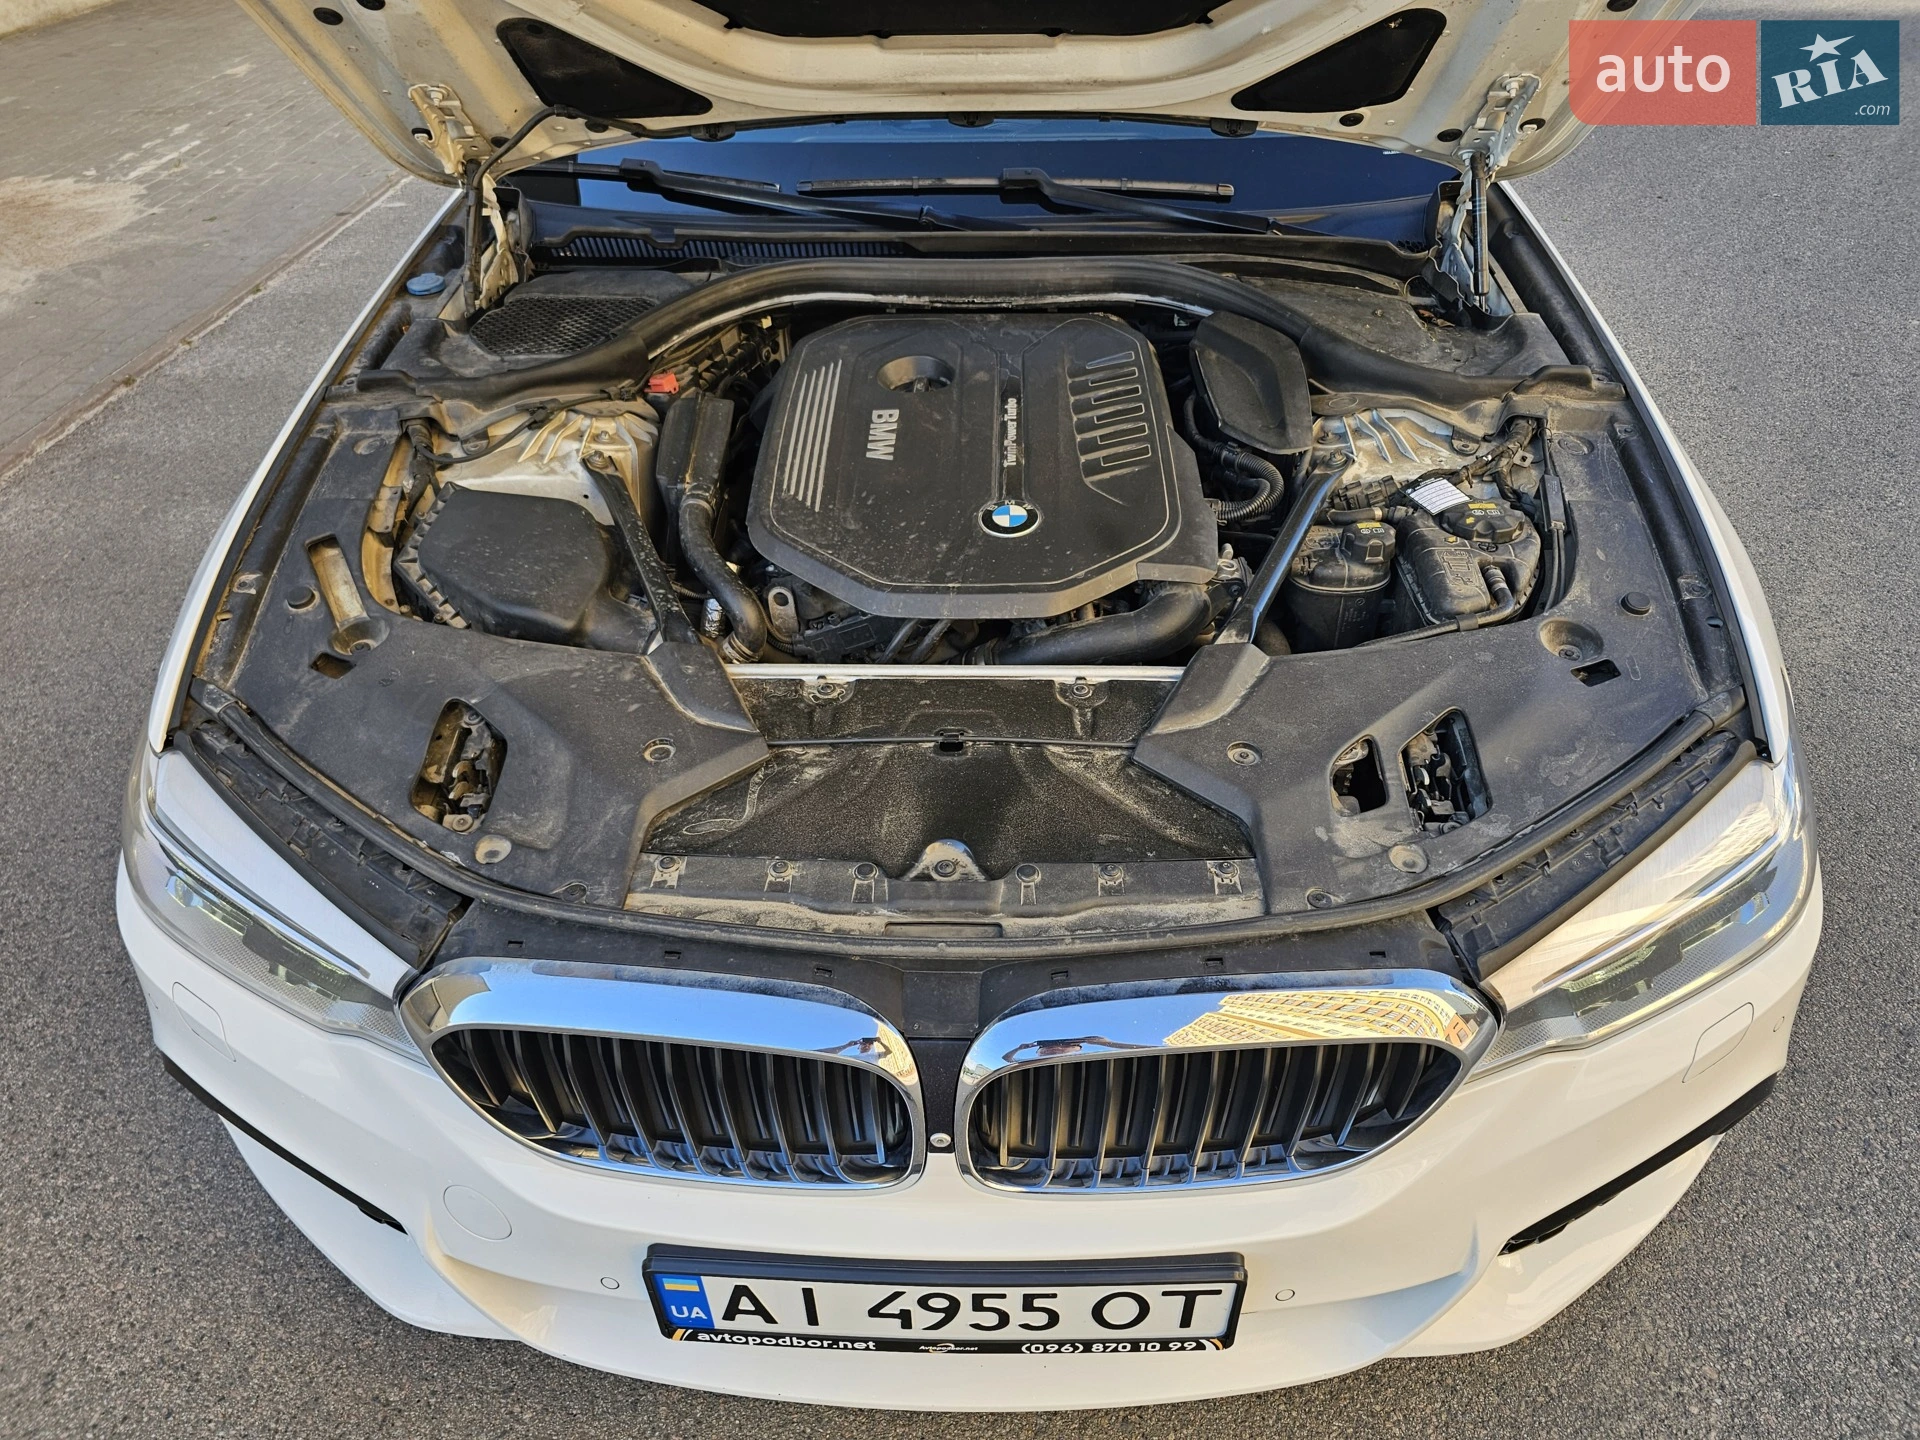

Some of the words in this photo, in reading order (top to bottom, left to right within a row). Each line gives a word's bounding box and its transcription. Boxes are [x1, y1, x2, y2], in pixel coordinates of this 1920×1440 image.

[1003, 397, 1018, 422] Turbo
[865, 408, 900, 461] BMW
[1003, 420, 1017, 468] TwinPower
[986, 499, 1035, 511] BMW
[670, 1304, 708, 1320] UA
[721, 1284, 820, 1327] AI
[867, 1290, 1060, 1332] 4955
[1091, 1288, 1223, 1331] OT
[696, 1331, 877, 1351] avtopodbor.net
[1021, 1342, 1084, 1354] (096)
[1090, 1342, 1132, 1353] 870
[1138, 1342, 1161, 1352] 10
[1167, 1340, 1197, 1351] 99
